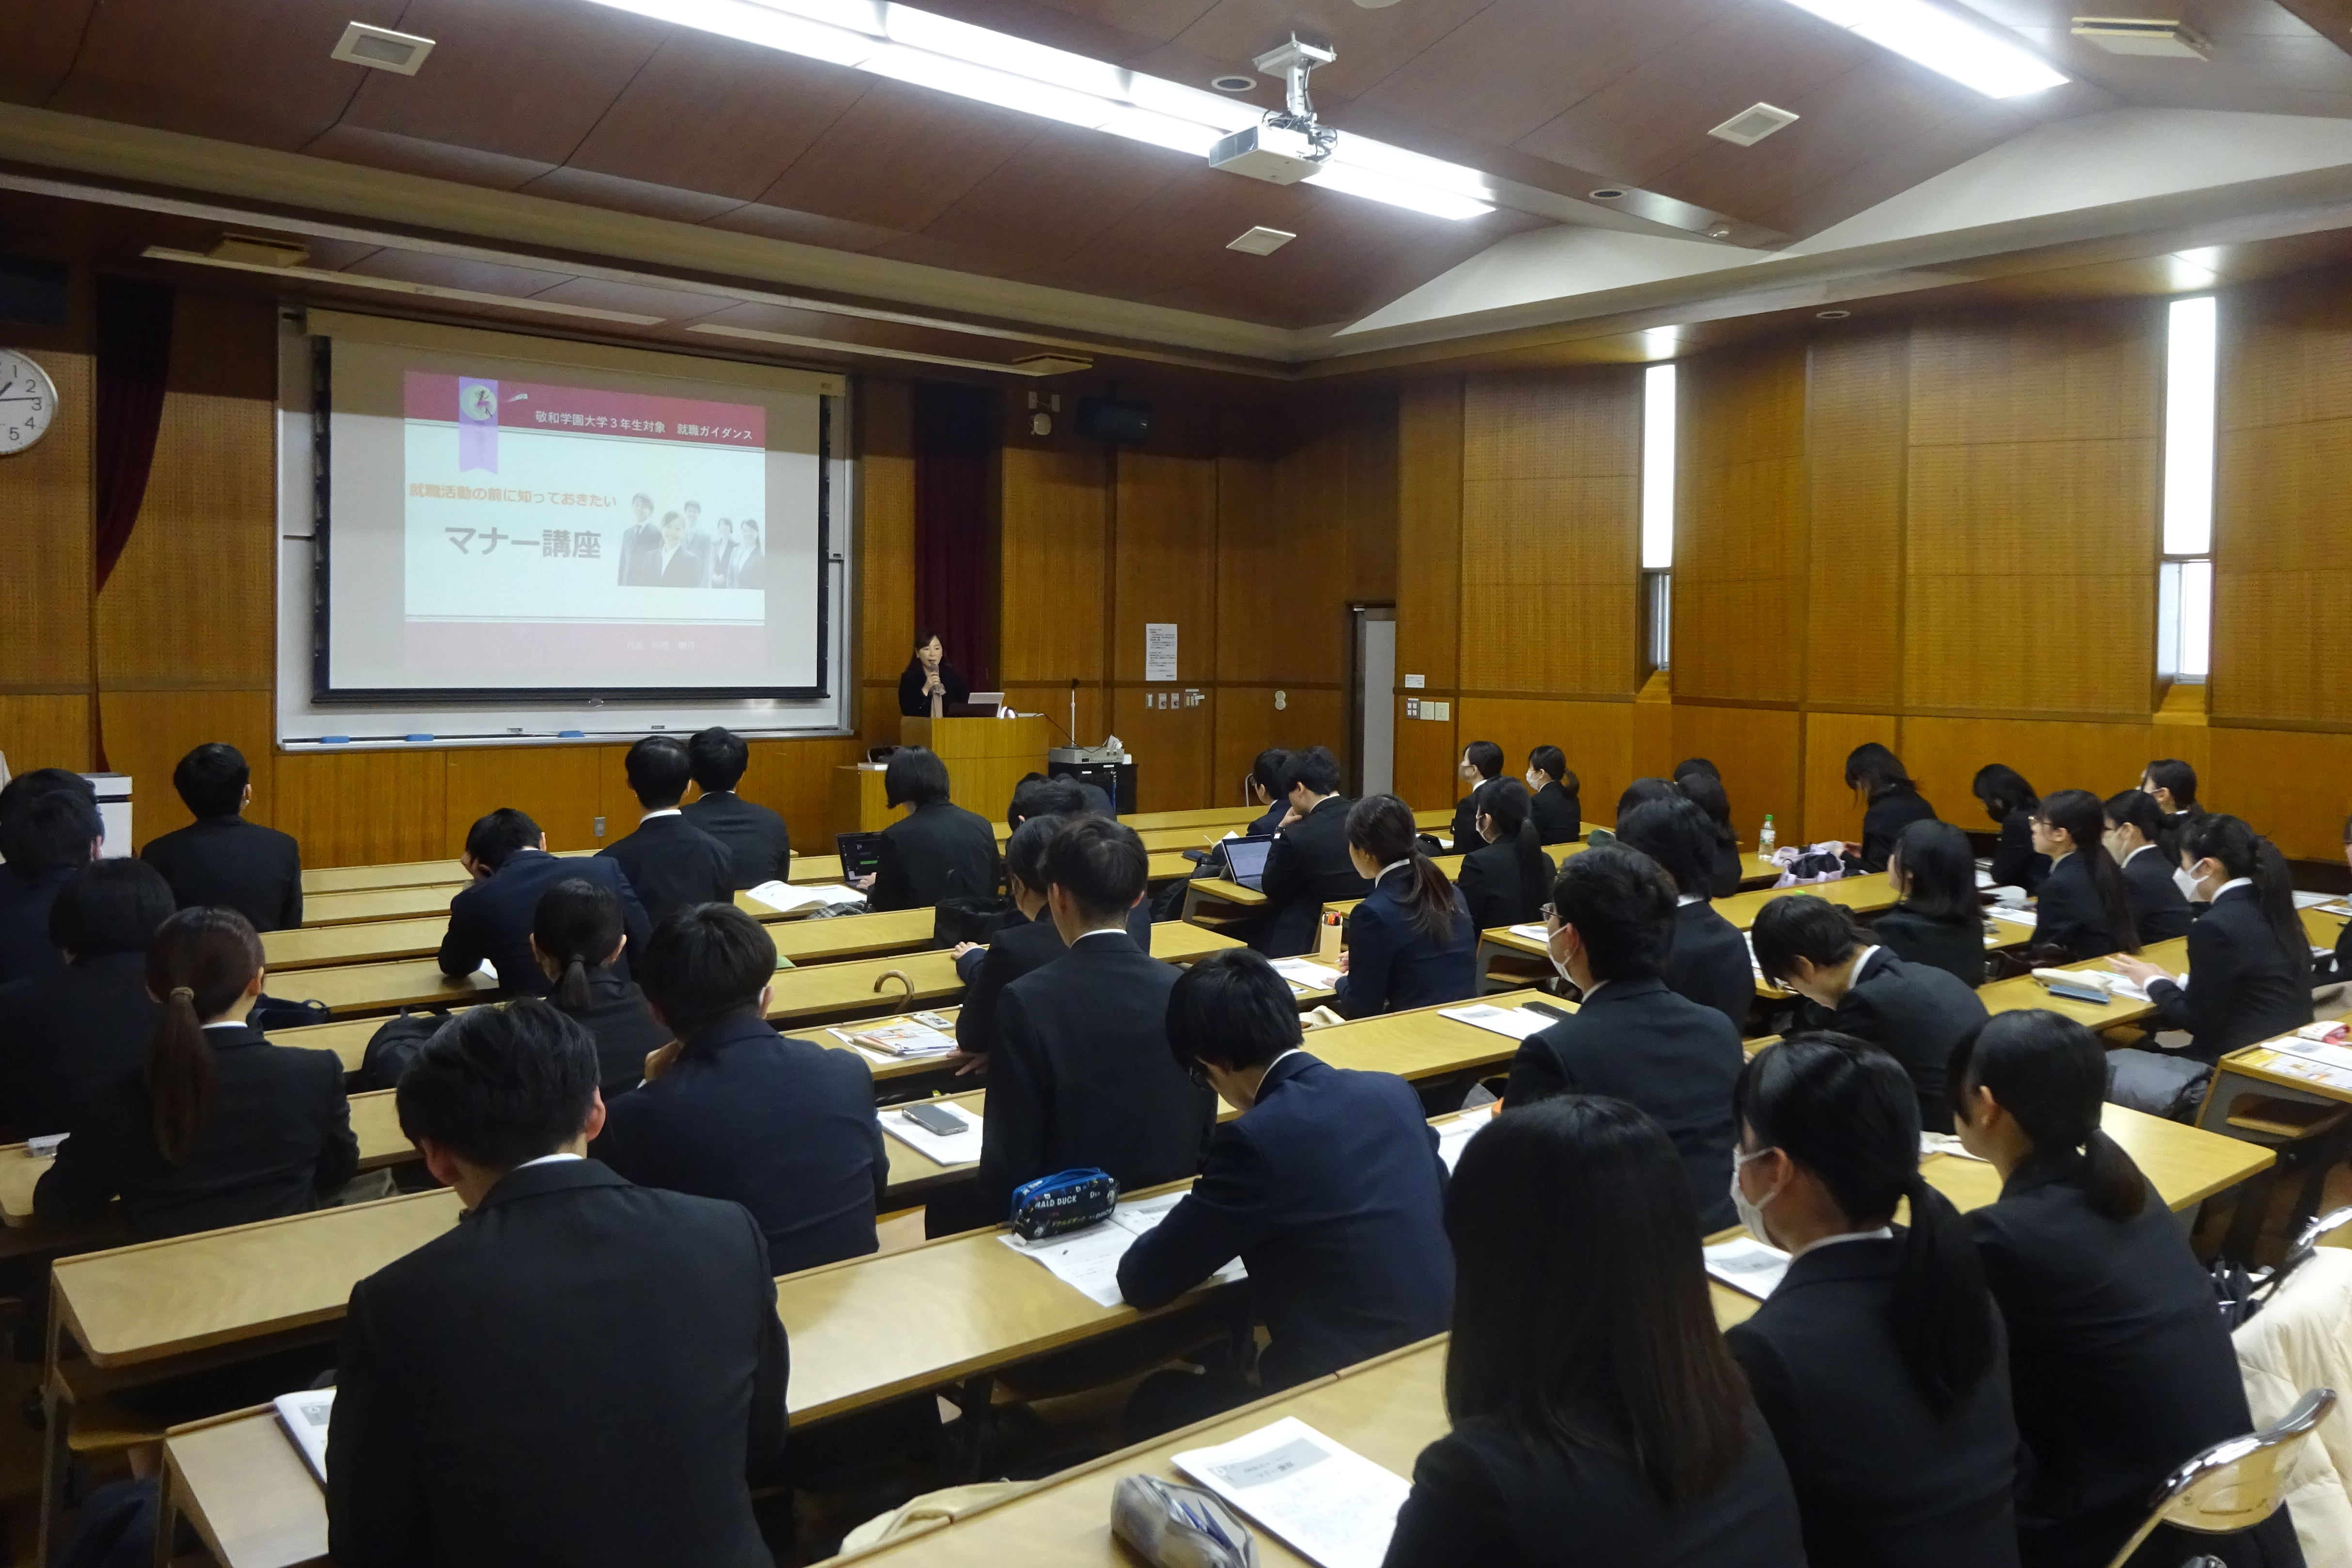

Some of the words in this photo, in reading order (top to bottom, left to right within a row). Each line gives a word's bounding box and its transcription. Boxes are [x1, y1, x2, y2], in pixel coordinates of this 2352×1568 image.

[13, 365, 17, 378] 1
[26, 380, 36, 393] 2
[32, 396, 42, 411] 3
[25, 417, 35, 429] 4
[9, 427, 20, 441] 5
[677, 423, 753, 440] 就職ガイダンス
[409, 482, 617, 507] 就職活動の前に知っておきたい
[444, 526, 601, 559] マナー講座
[1057, 1194, 1077, 1206] DUCK
